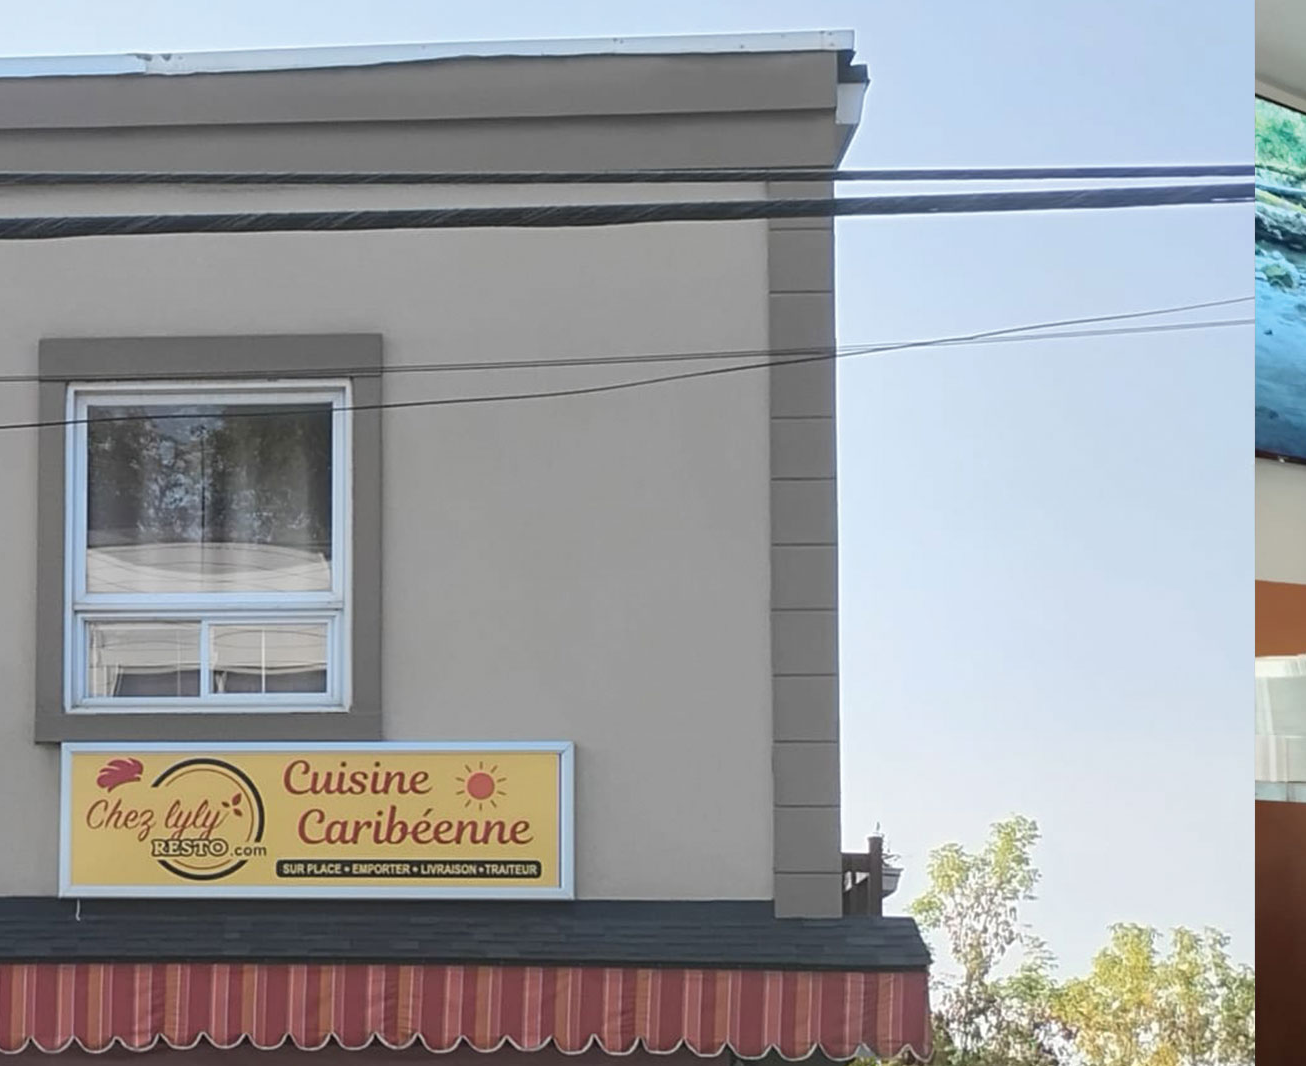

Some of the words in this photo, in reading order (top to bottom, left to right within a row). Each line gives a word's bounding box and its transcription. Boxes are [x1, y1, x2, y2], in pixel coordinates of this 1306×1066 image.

[283, 760, 432, 796] Cuisine
[86, 798, 154, 842] Chez
[298, 805, 534, 846] Caribéenne
[283, 863, 305, 874] SUR
[307, 864, 341, 874] PLACE
[352, 863, 410, 875] EMPORTER
[421, 864, 476, 875] LIVRAISON
[486, 864, 538, 875] TRAITEUR
